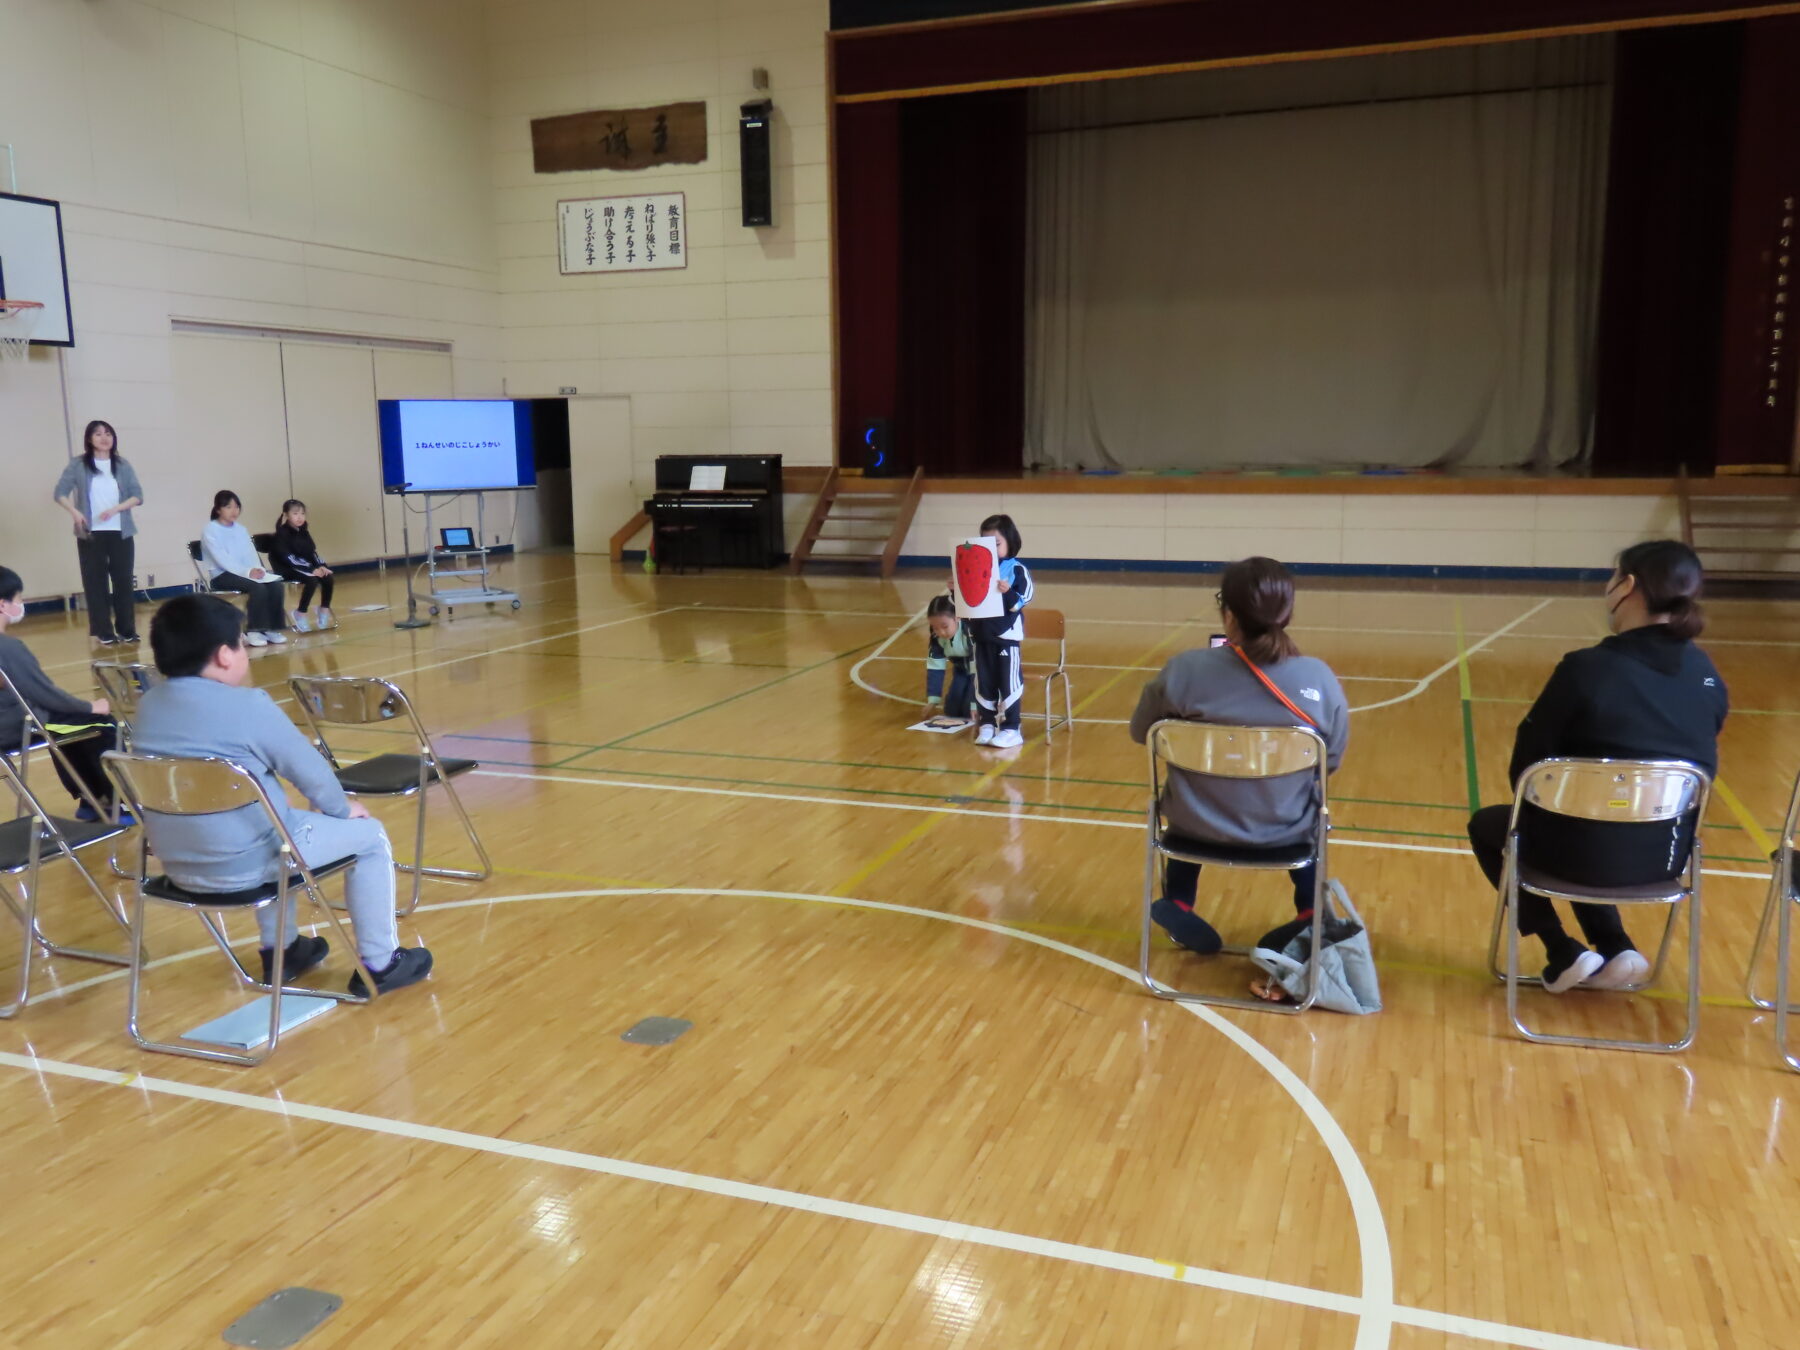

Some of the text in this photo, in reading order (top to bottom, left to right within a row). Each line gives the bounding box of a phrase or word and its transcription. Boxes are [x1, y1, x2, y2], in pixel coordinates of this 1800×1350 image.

[603, 206, 616, 264] 助け合う子
[624, 205, 636, 263] 考える子
[667, 204, 681, 255] 教育目標
[415, 441, 501, 449] 1ねんせいのじこしょうかい
